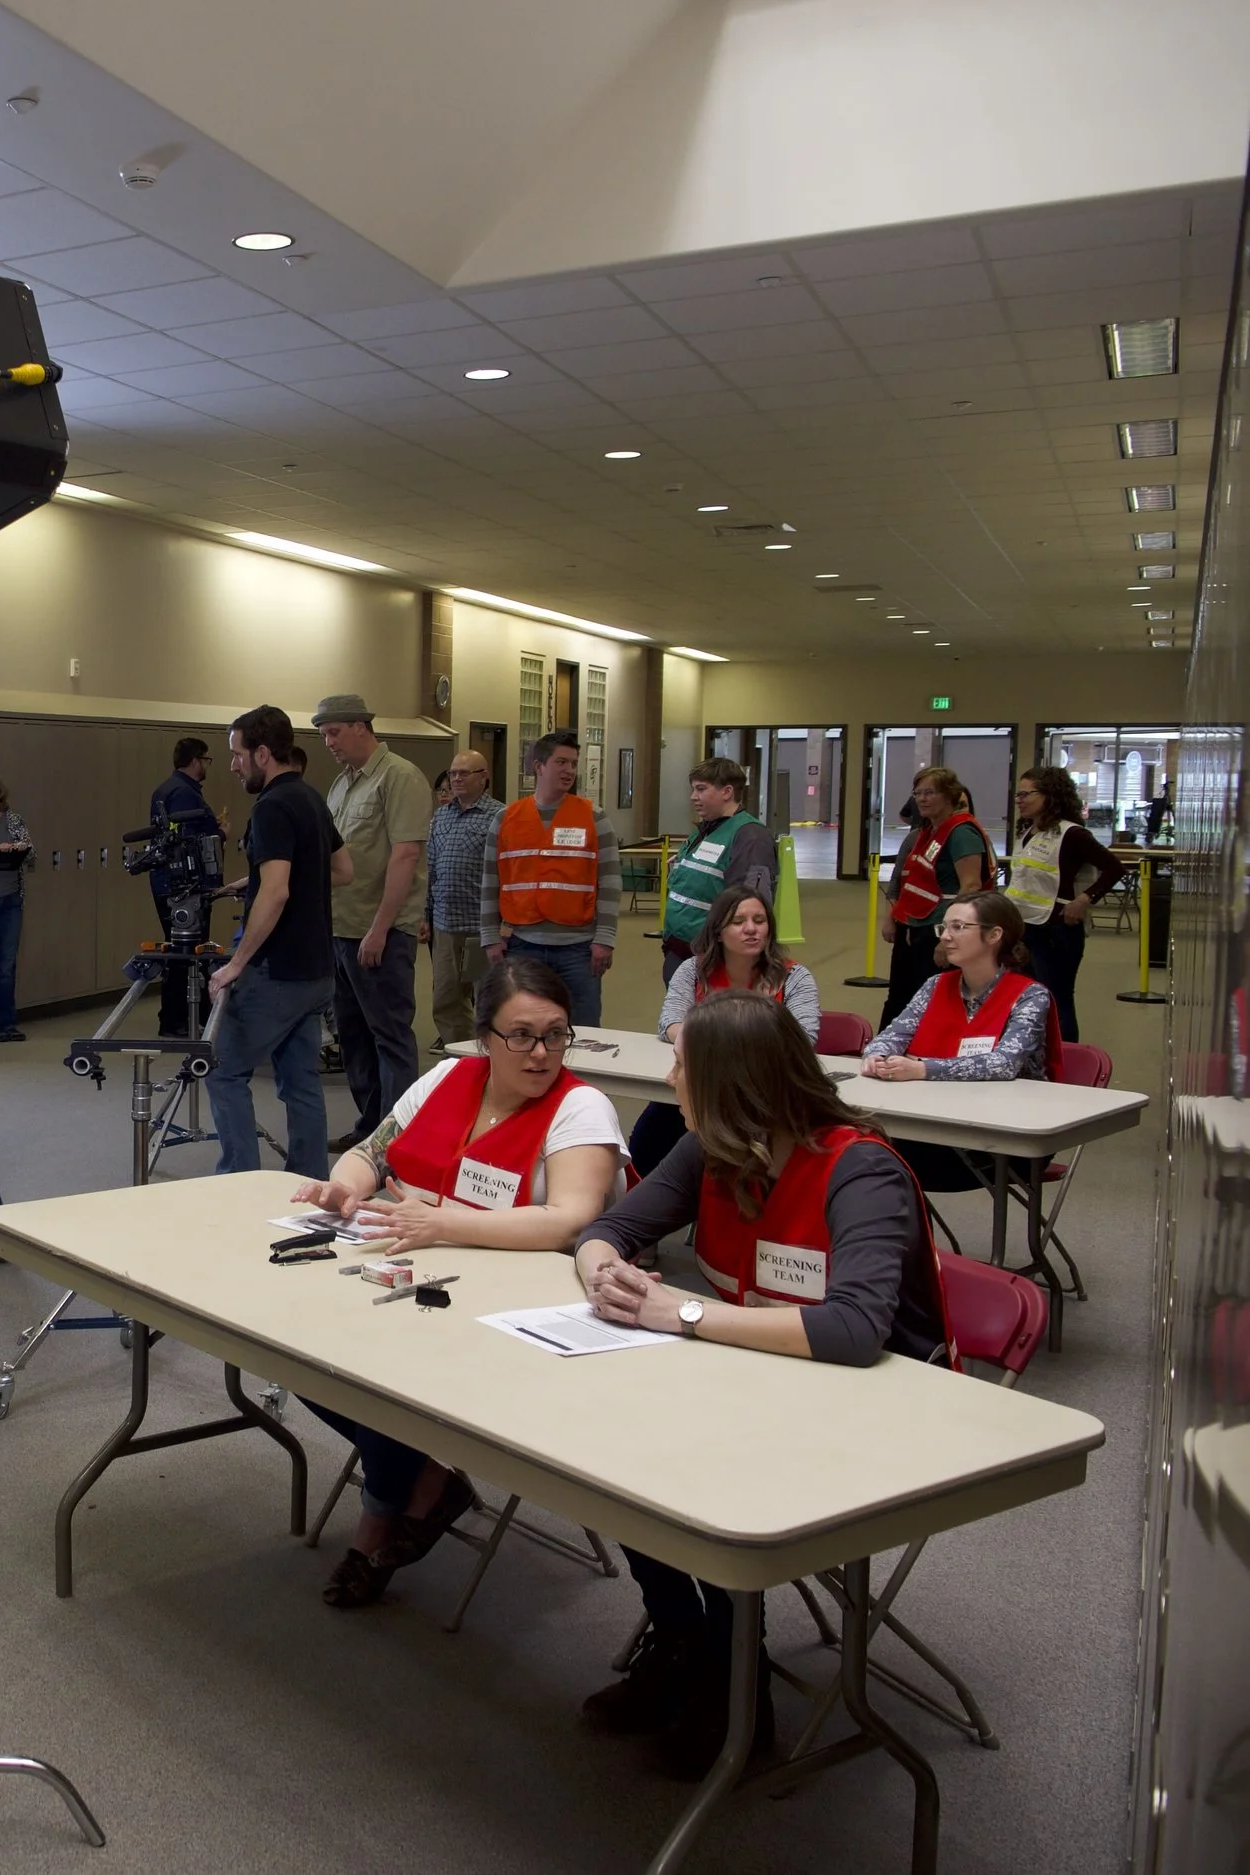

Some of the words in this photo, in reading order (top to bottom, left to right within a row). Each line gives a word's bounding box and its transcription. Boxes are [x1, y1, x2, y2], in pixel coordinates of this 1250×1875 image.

[461, 1168, 516, 1193] SCREENING
[471, 1183, 498, 1199] TEAM
[758, 1251, 822, 1274] SCREENING
[773, 1268, 806, 1285] TEAM
